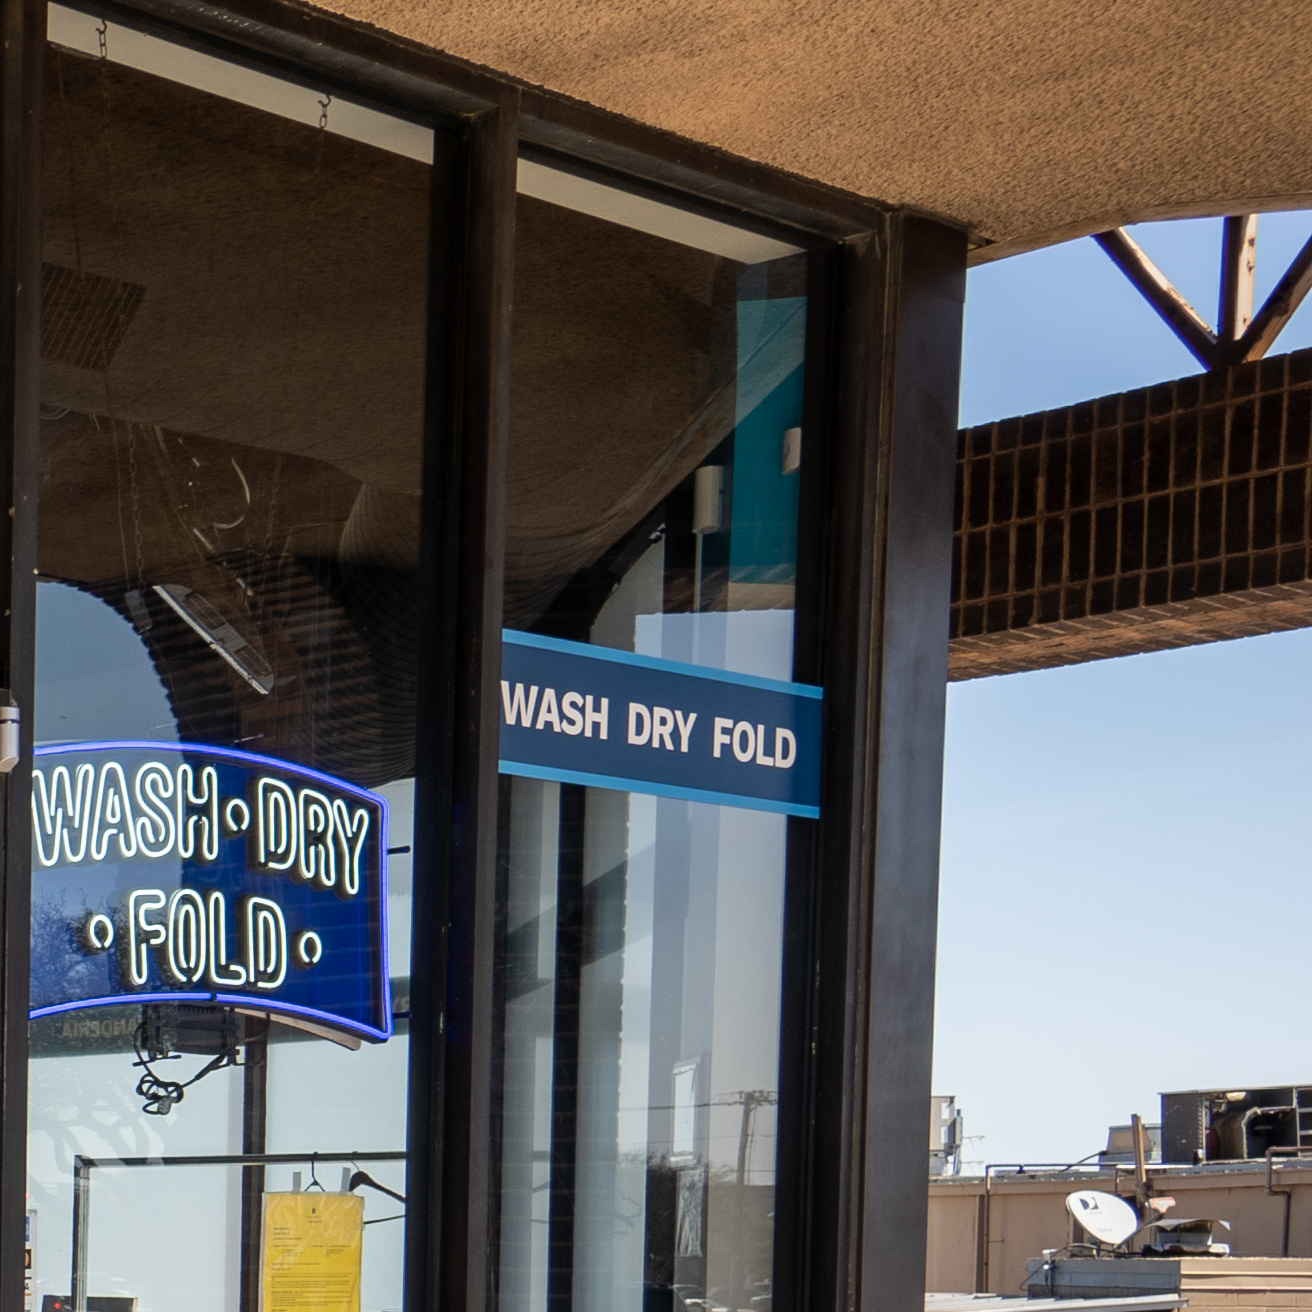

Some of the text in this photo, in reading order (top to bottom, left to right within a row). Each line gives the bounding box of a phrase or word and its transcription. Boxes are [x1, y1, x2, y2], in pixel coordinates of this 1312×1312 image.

[500, 680, 797, 769] WASH DRY FOLD
[128, 888, 287, 989] FOLD
